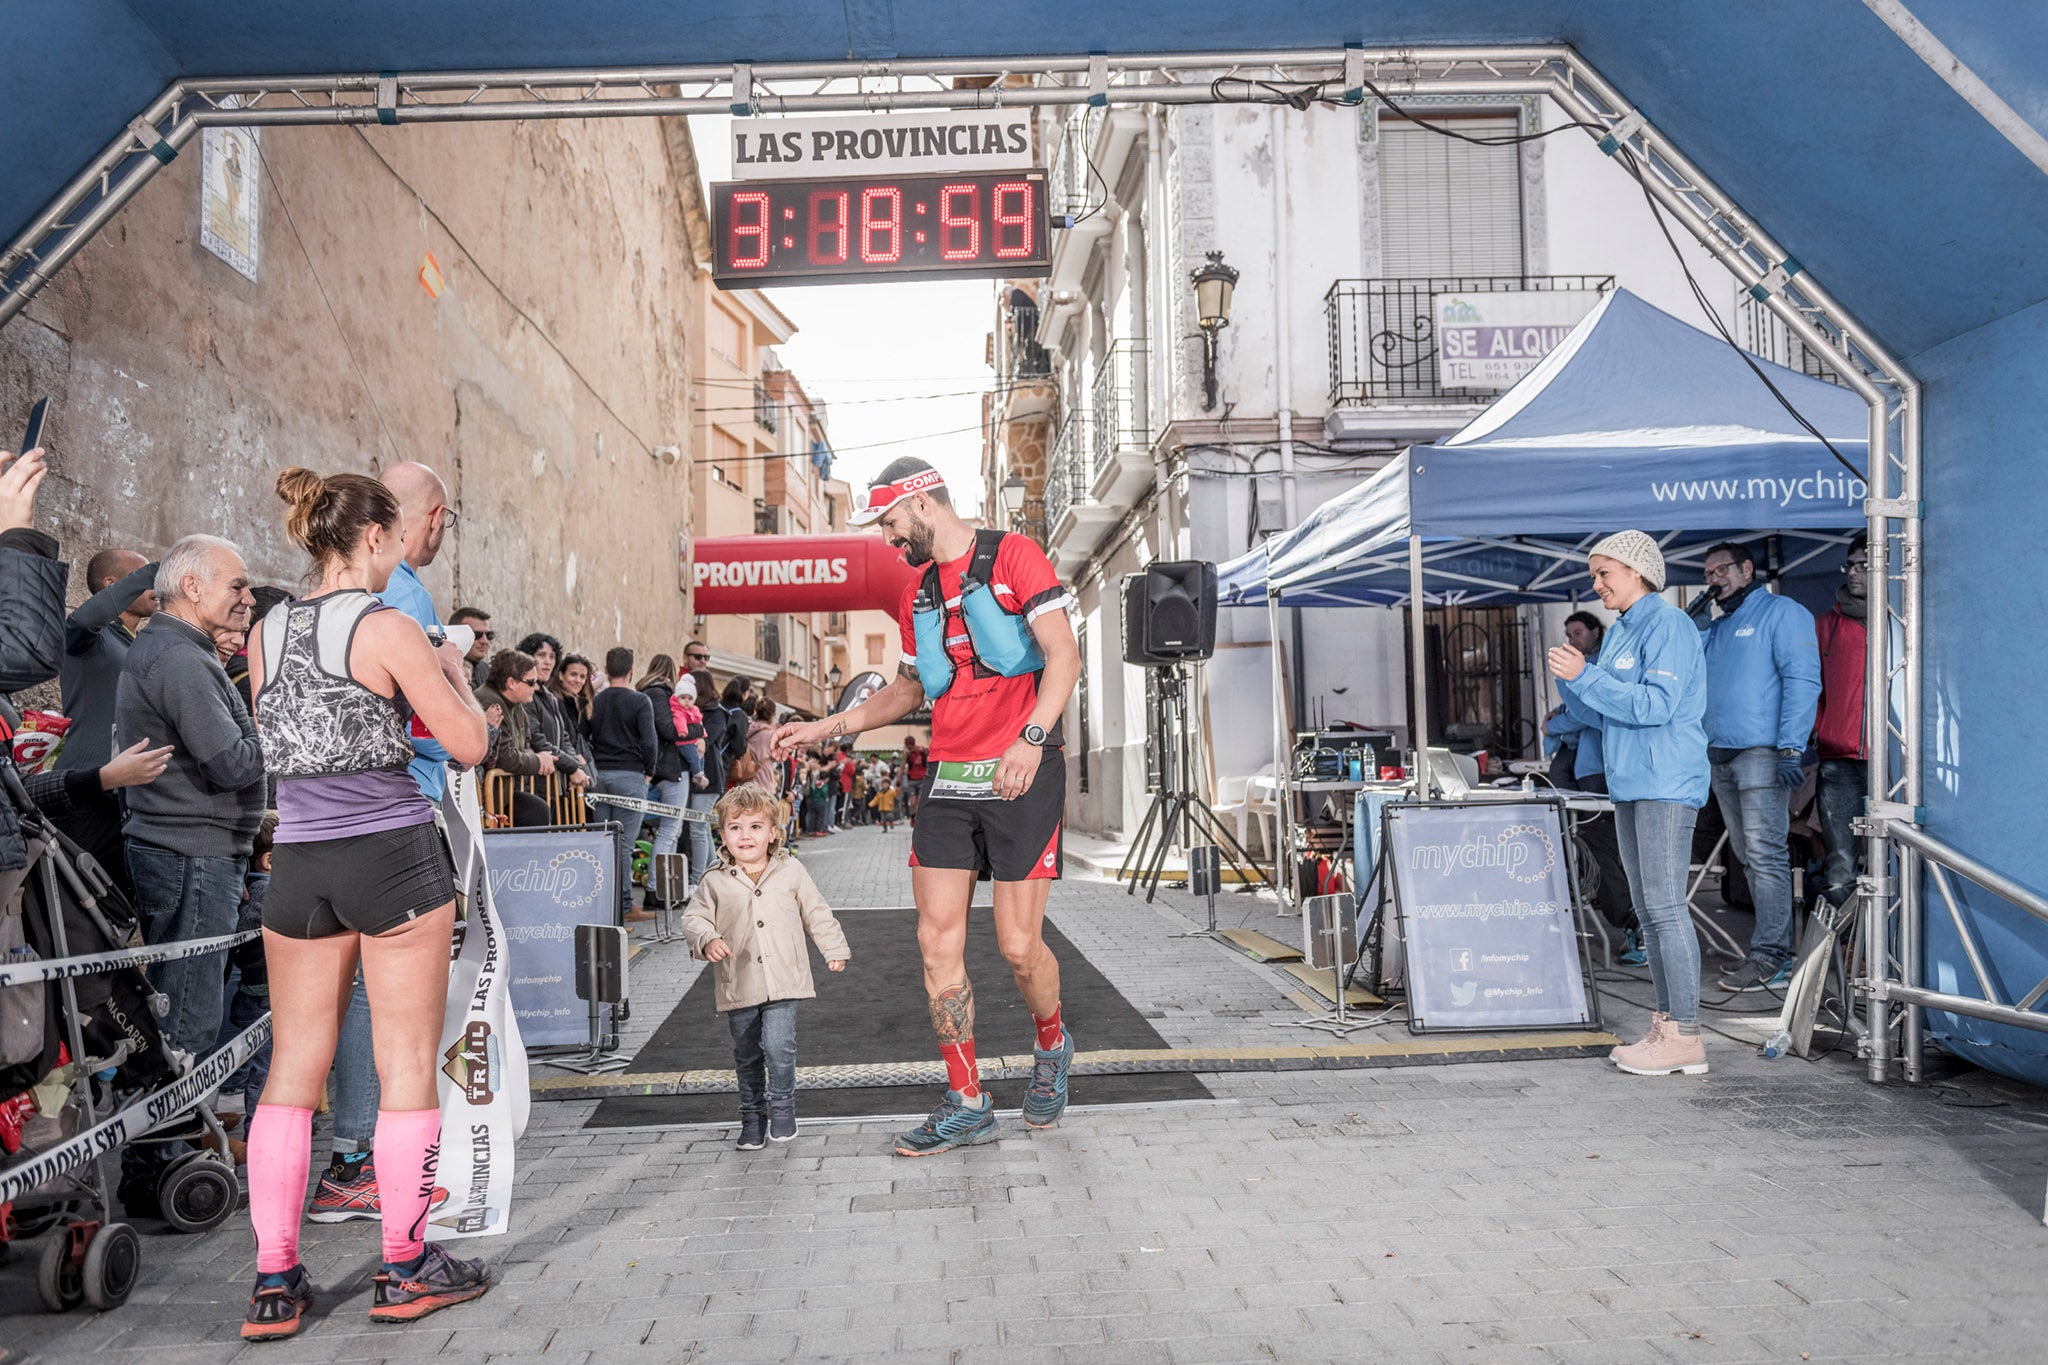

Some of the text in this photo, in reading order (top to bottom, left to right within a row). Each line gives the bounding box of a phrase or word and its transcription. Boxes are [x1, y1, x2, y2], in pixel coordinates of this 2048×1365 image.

[736, 123, 1028, 163] LAS PROVINCIAS
[1446, 329, 1479, 357] SE
[1449, 363, 1476, 380] TEL
[693, 558, 848, 587] PROVINCIAS
[961, 763, 996, 778] 707
[1411, 834, 1529, 876] mychip
[487, 860, 578, 900] ychip
[1416, 899, 1558, 921] www.mychip.es
[471, 977, 492, 1013] LAS
[146, 1046, 236, 1126] LAS PROVINCIAS
[97, 1118, 128, 1157] LAS
